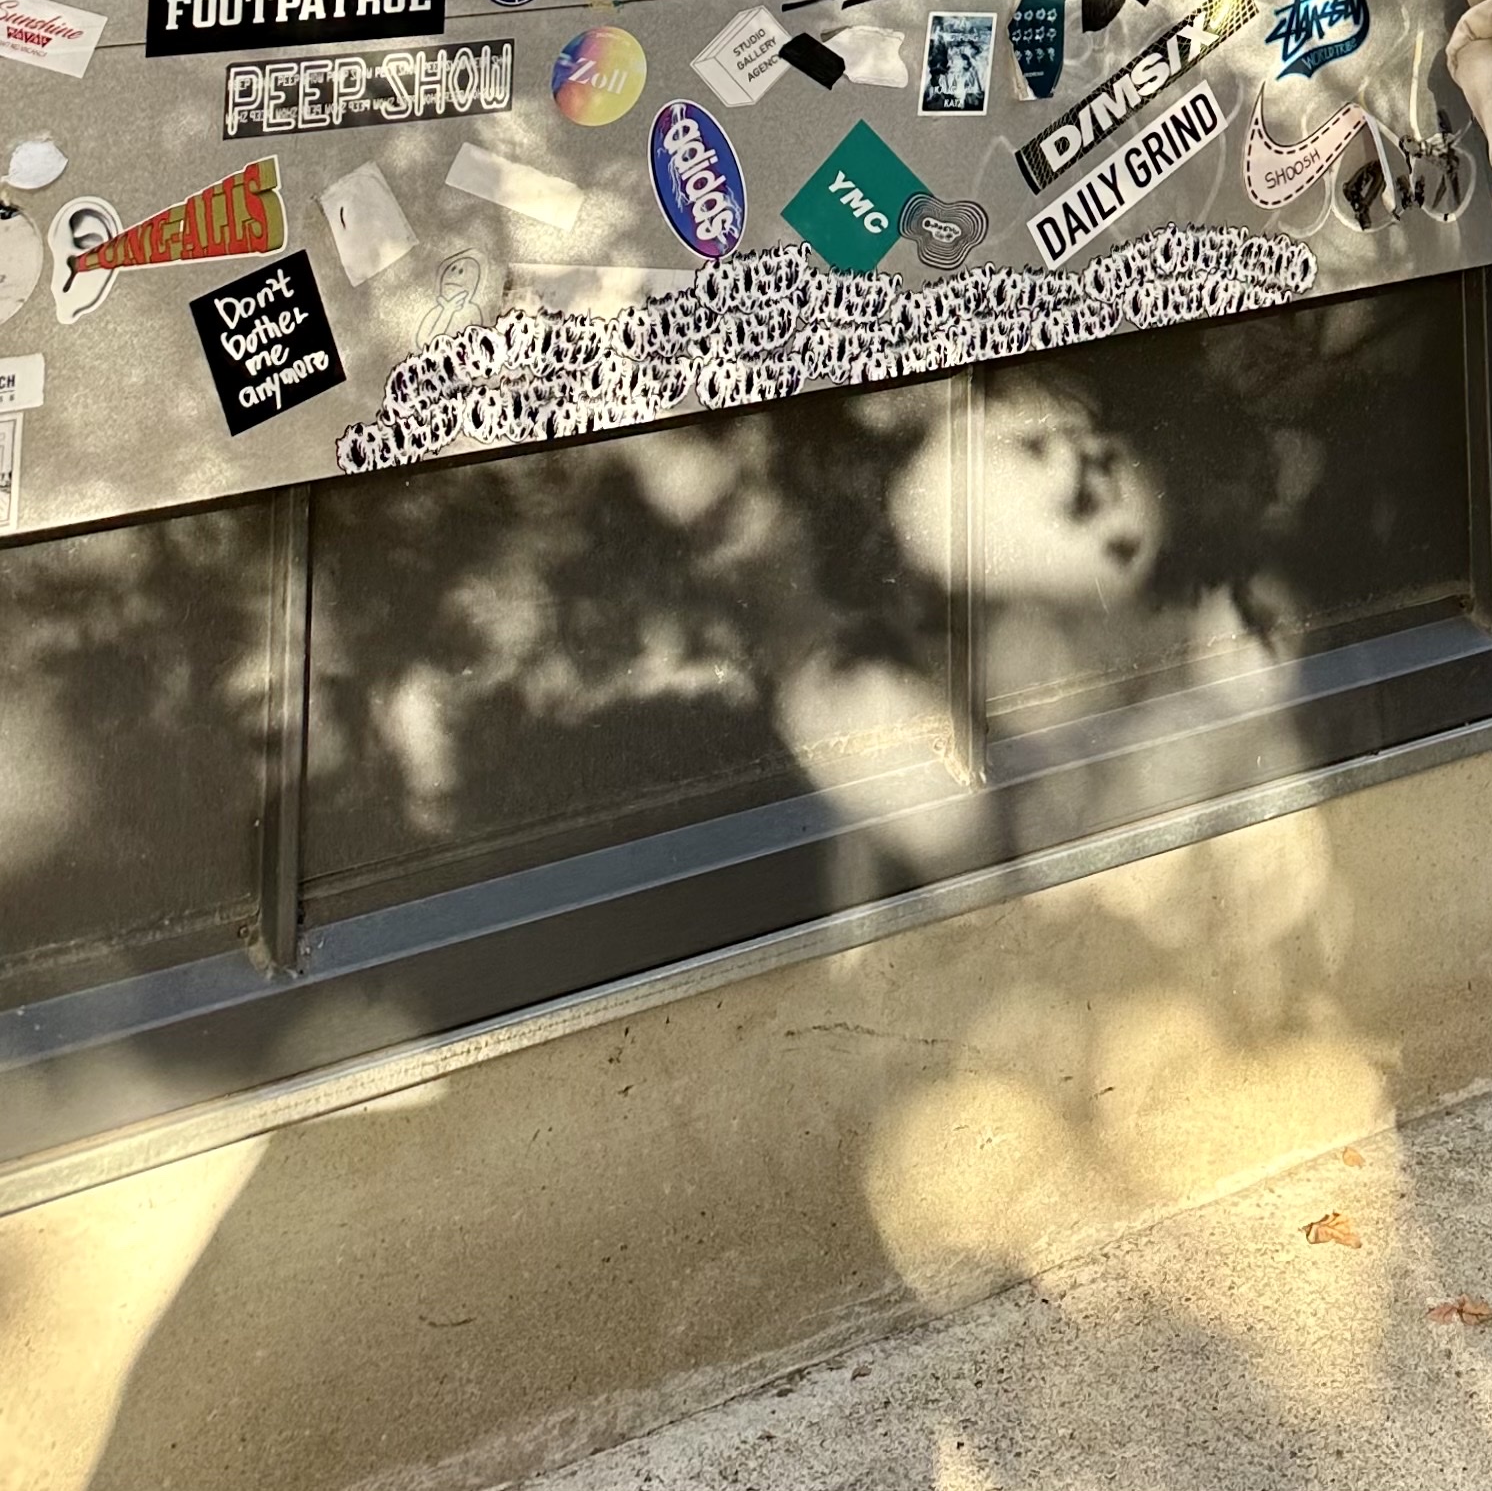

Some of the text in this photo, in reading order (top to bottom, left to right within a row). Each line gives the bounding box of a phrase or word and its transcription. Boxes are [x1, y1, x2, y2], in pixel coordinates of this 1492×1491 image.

[0, 0, 83, 39] Sunshine
[732, 28, 766, 58] STUDIO
[568, 57, 627, 96] Zoll
[736, 36, 777, 71] GALLERY
[227, 42, 512, 135] PEEP SHOW
[663, 116, 738, 242] adidas
[1036, 91, 1220, 261] DAILY GRIND
[1264, 148, 1321, 189] SHOOSH
[827, 170, 890, 235] YMC
[220, 308, 309, 361] bother
[238, 350, 329, 410] anymore
[245, 345, 290, 376] me
